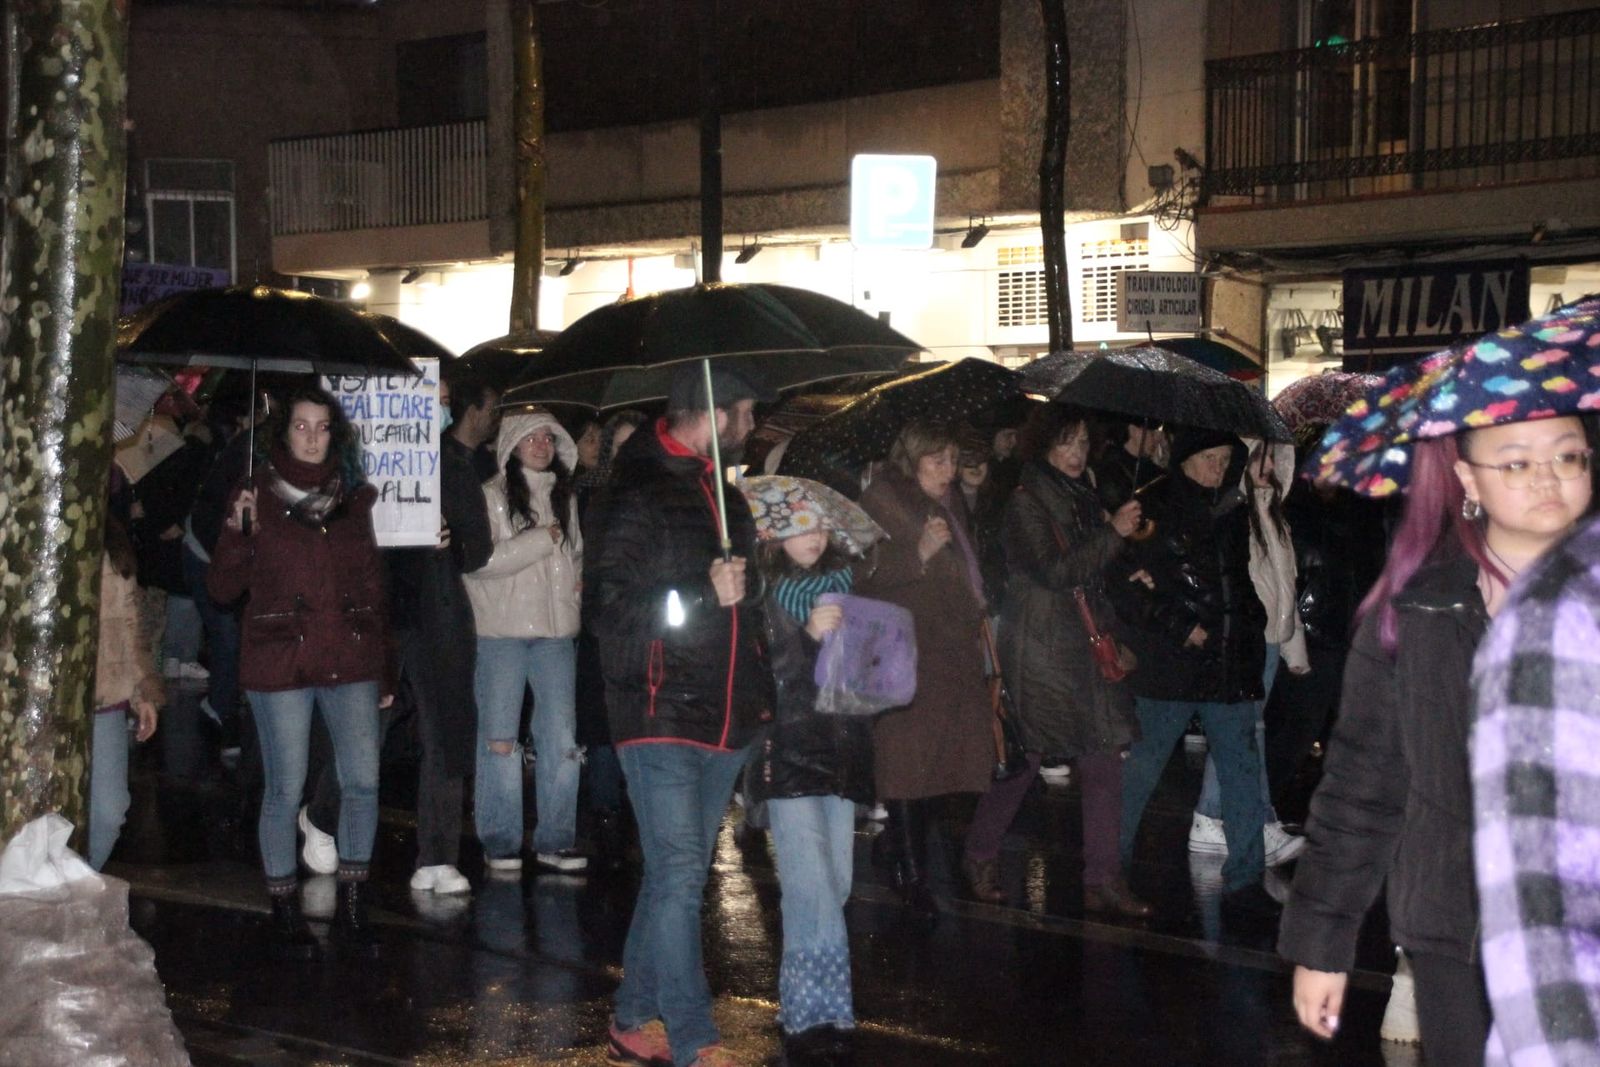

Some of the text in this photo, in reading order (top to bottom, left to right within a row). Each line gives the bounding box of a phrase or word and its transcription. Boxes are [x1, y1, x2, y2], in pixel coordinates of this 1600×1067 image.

[870, 168, 918, 238] P
[170, 270, 214, 288] MUJER
[1127, 275, 1197, 292] TRAUMATOLOGIA
[1159, 298, 1197, 315] ARTICULAR
[1357, 271, 1513, 338] MILAN
[339, 391, 433, 419] EALTCARE
[361, 421, 430, 445] UCATION
[360, 449, 439, 477] IDARITY
[380, 480, 432, 504] ALL
